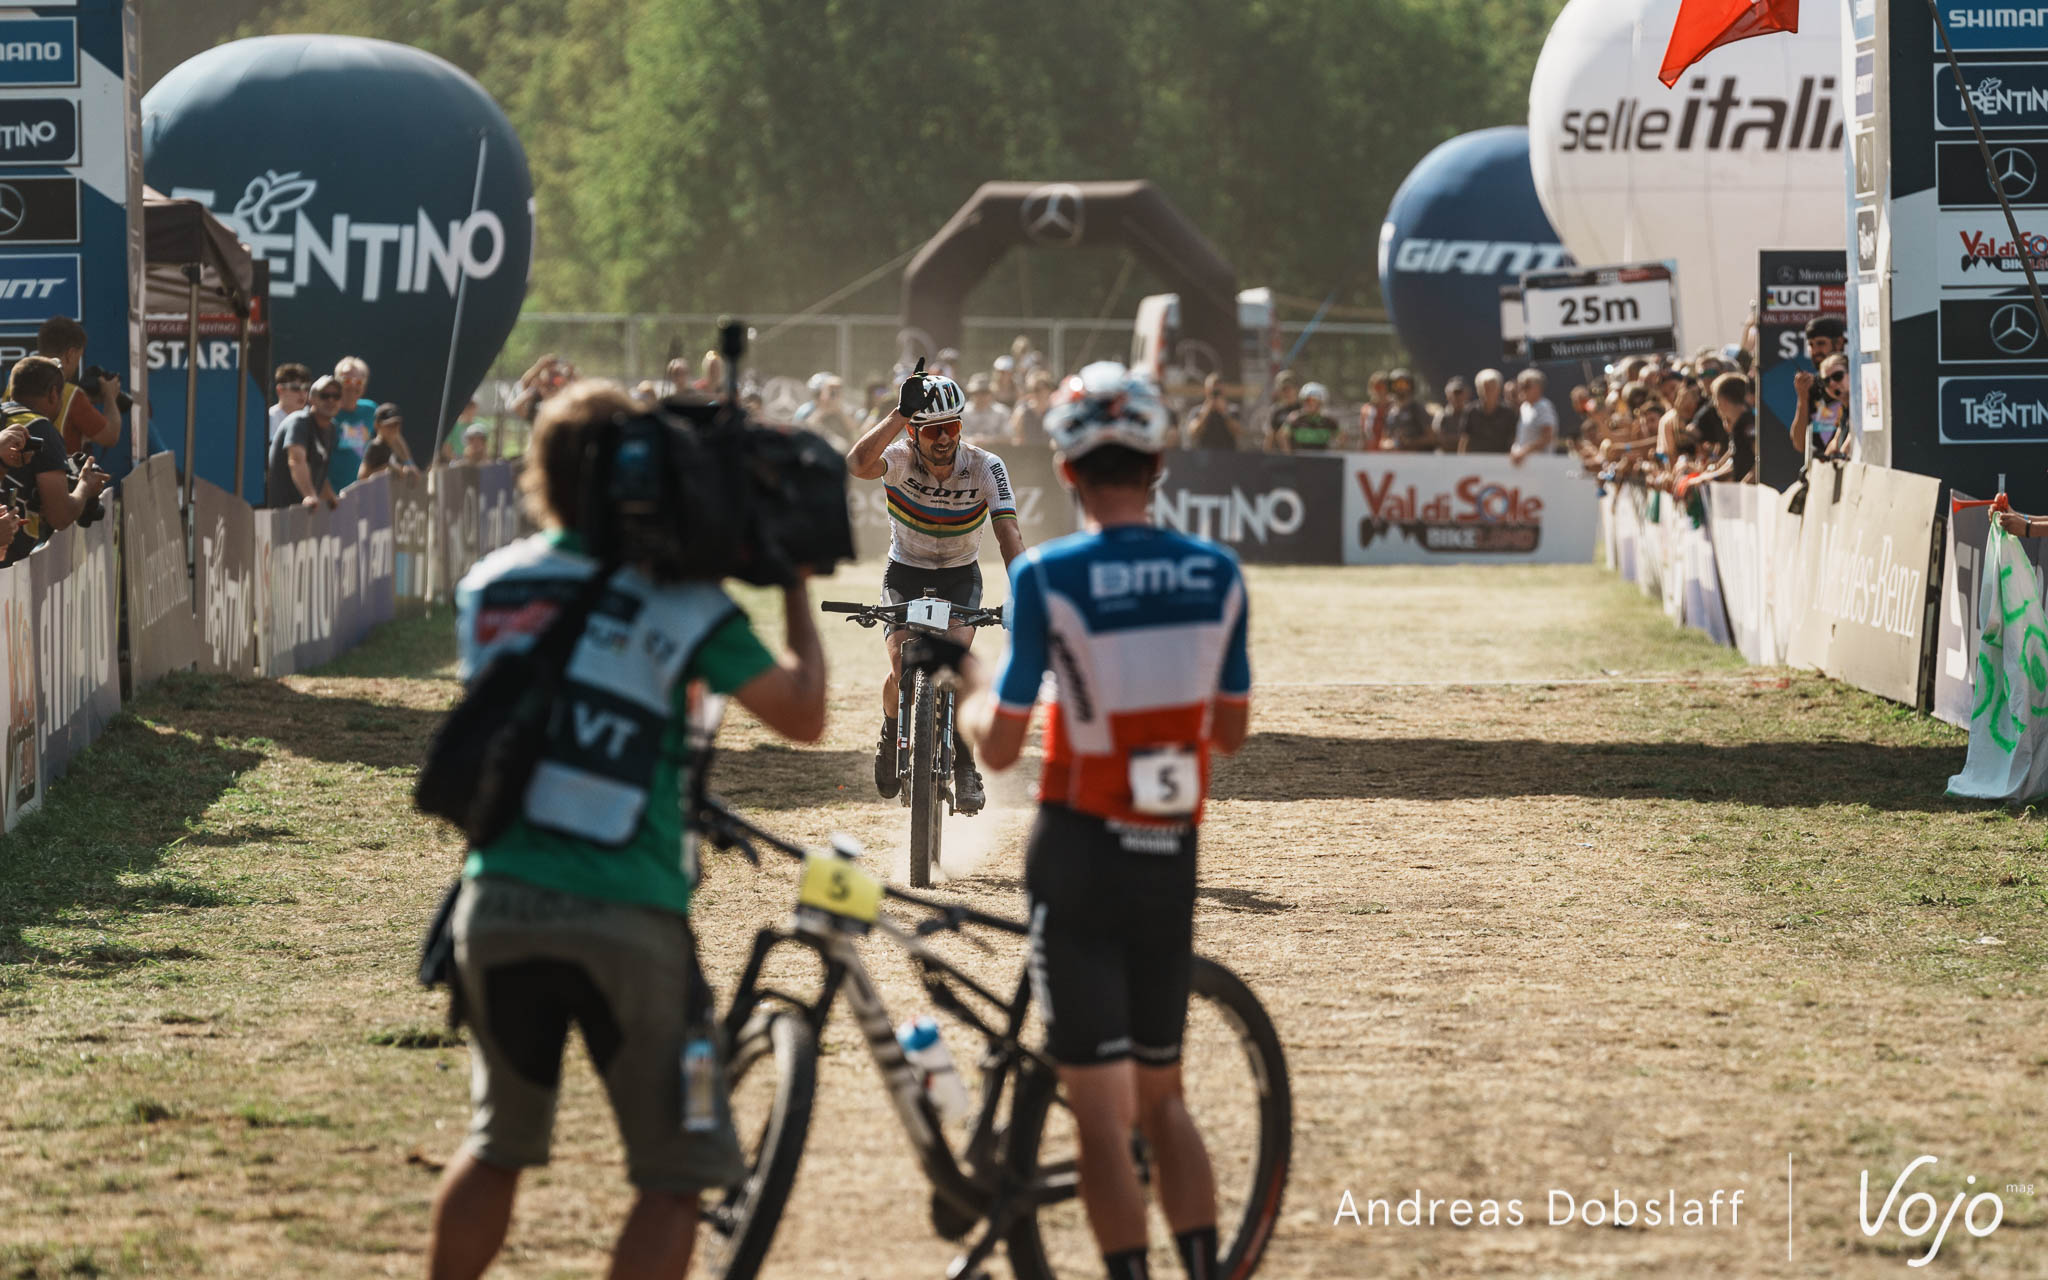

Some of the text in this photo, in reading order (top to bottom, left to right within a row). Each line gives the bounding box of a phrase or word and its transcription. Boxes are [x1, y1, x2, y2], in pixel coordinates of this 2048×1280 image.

[1560, 98, 1671, 151] selle
[1560, 296, 1639, 326] 25m
[1777, 290, 1816, 307] UCI
[903, 477, 979, 499] SCOTT
[1356, 471, 1543, 522] Val di Sole
[1145, 486, 1304, 544] NTINO
[925, 605, 933, 620] 1
